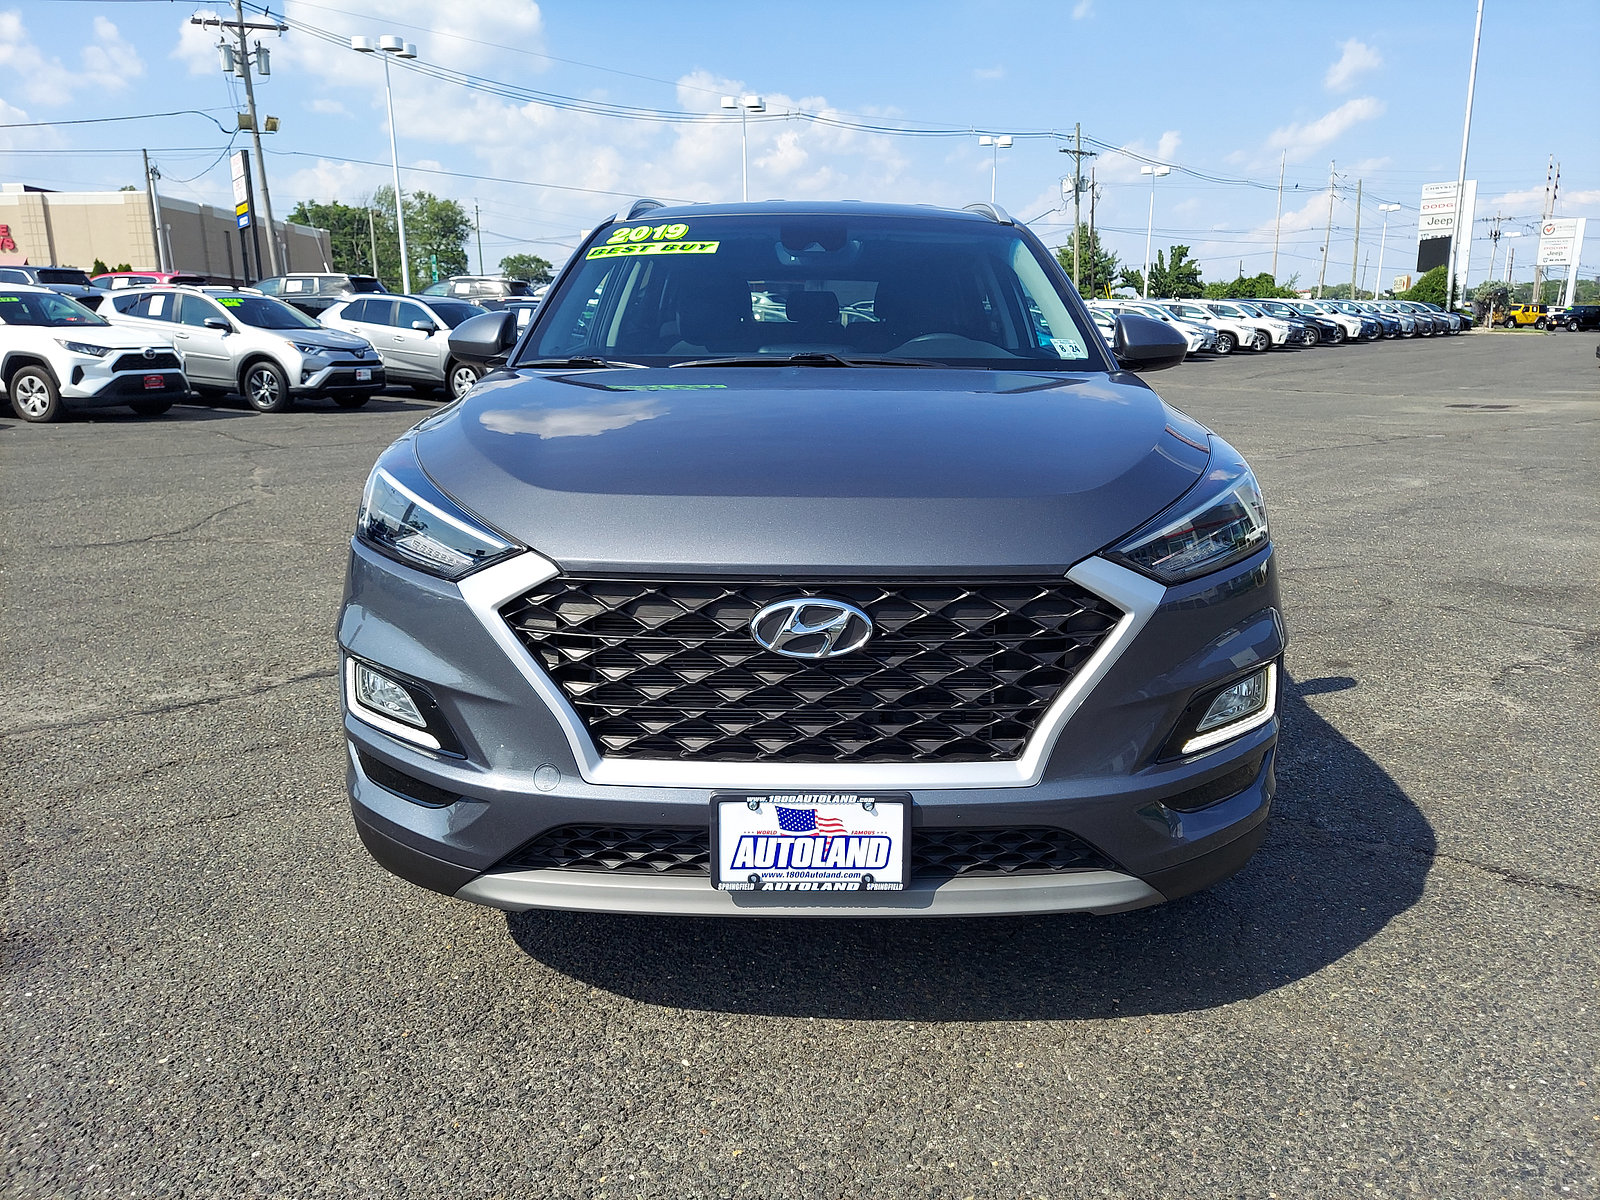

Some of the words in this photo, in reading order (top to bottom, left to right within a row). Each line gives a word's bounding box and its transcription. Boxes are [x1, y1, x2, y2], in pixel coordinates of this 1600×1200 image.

[1427, 217, 1453, 226] Jeep
[606, 223, 689, 244] 2019
[588, 244, 655, 257] BEST
[660, 243, 716, 252] BUY
[747, 794, 876, 804] www.1800AUTOLAND.com
[730, 835, 892, 870] AUTOLAND
[761, 871, 861, 879] www.1800Autoland.com
[718, 883, 755, 891] SPRINGFIELD
[761, 882, 860, 891] AUTOLAND
[866, 883, 904, 891] SPRINGFIELD
